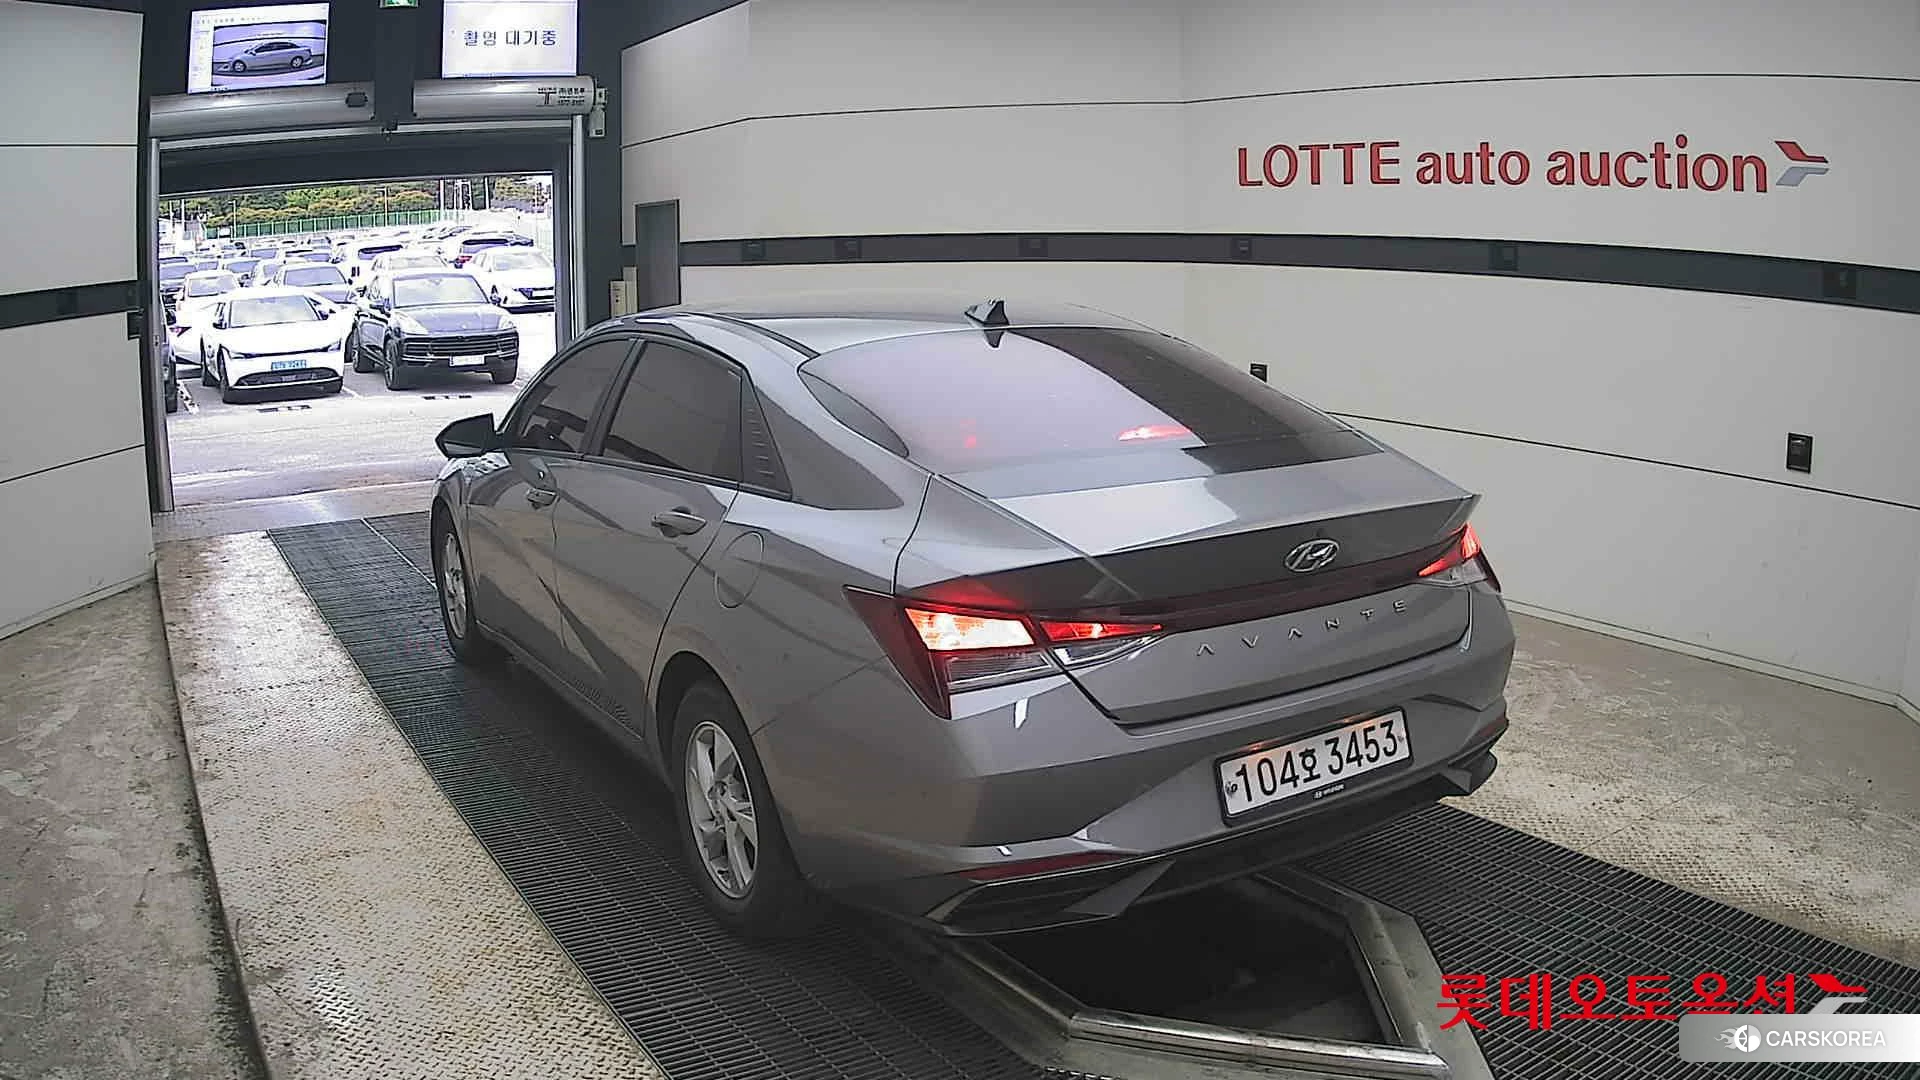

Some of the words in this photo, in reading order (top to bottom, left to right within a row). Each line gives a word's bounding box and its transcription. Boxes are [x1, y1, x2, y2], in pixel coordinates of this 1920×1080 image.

[463, 30, 497, 46] 촬영
[505, 30, 556, 46] 대기중
[1238, 141, 1400, 187] LOTTE
[1416, 142, 1531, 186] auto
[1546, 134, 1768, 193] auction
[1197, 600, 1407, 656] AVANTE
[1325, 720, 1398, 775] 3453
